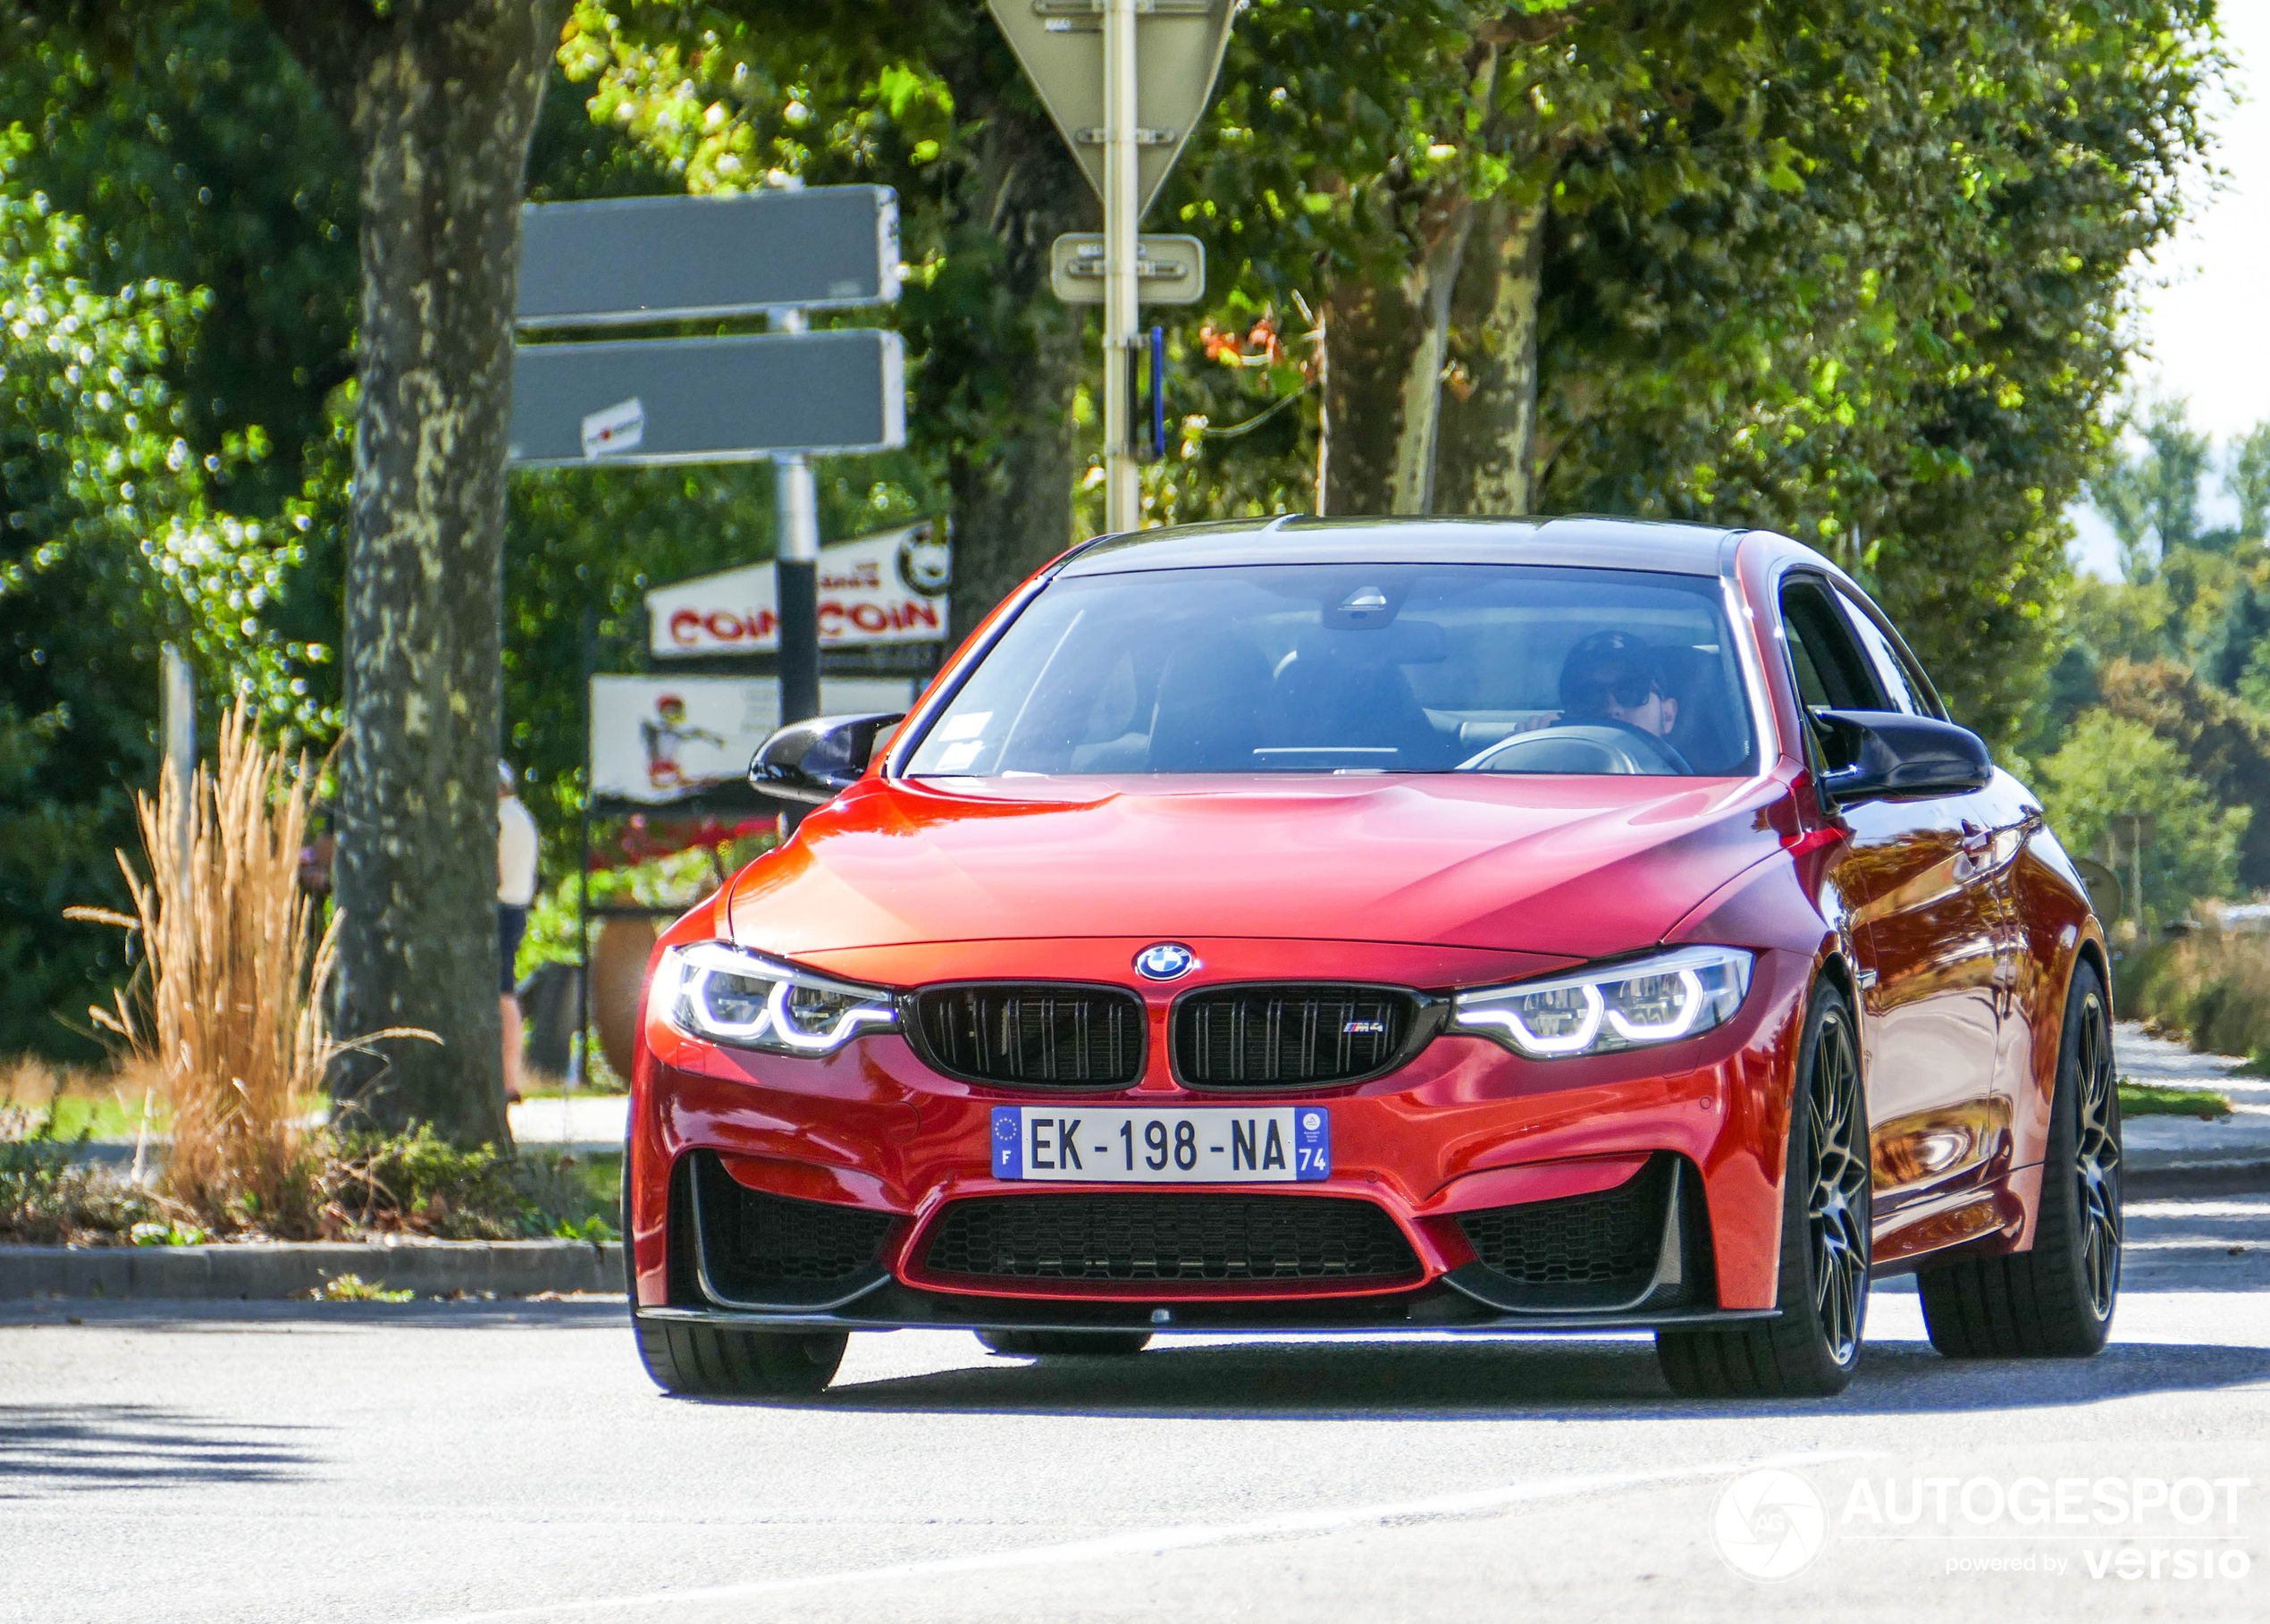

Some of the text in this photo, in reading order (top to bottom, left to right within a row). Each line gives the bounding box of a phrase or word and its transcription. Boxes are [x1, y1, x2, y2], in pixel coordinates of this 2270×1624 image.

[1347, 1022, 1383, 1032] M4
[1002, 1150, 1012, 1165] F
[1299, 1148, 1326, 1171] 74
